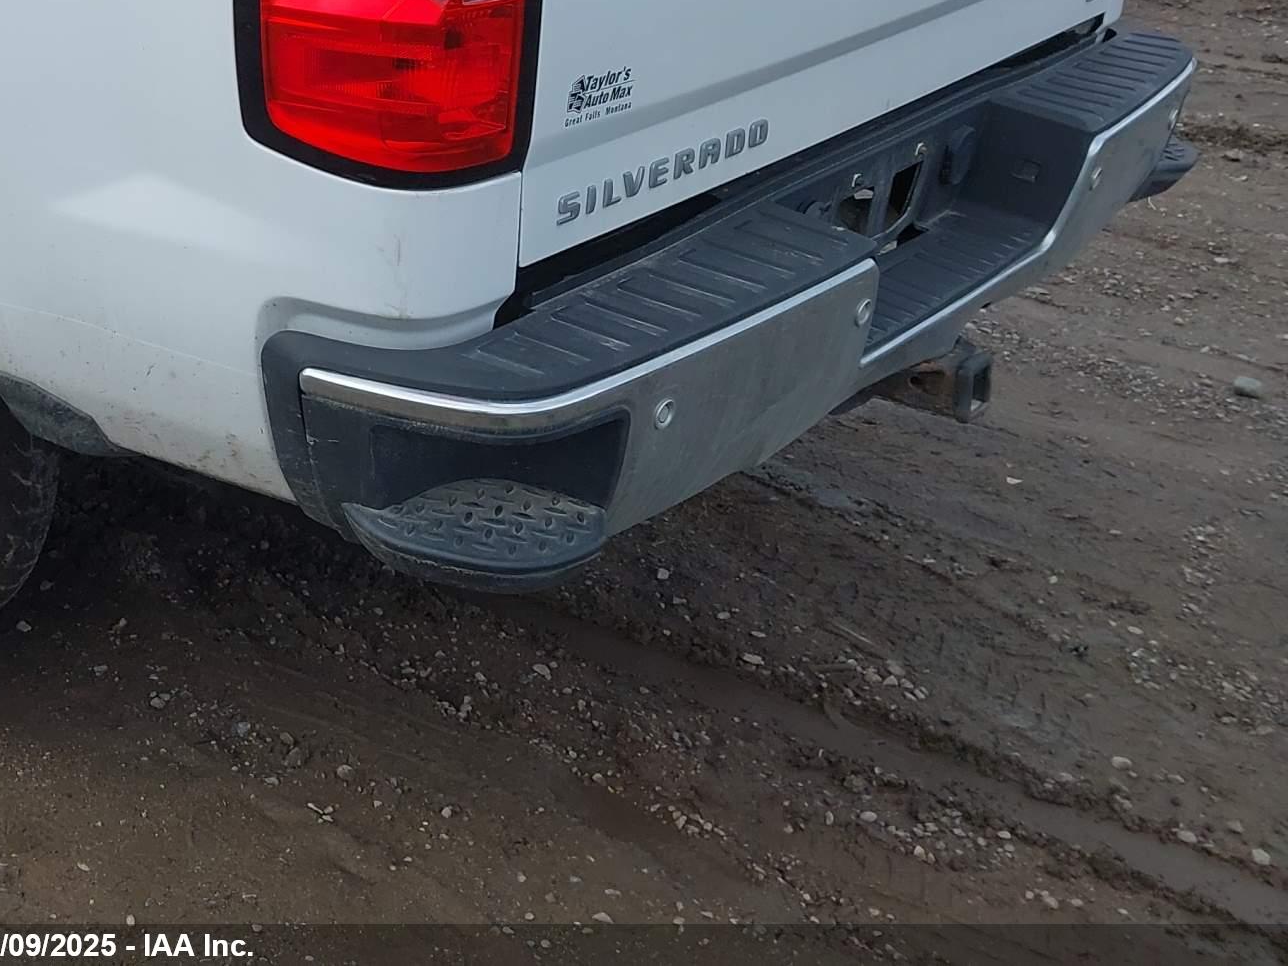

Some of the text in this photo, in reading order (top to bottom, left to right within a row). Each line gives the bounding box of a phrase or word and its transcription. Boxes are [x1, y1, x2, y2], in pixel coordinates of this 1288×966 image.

[585, 66, 632, 92] Taylor's
[584, 85, 633, 109] Auto Max
[564, 101, 632, 127] Great Falls Montana
[556, 118, 769, 226] SILVERADO
